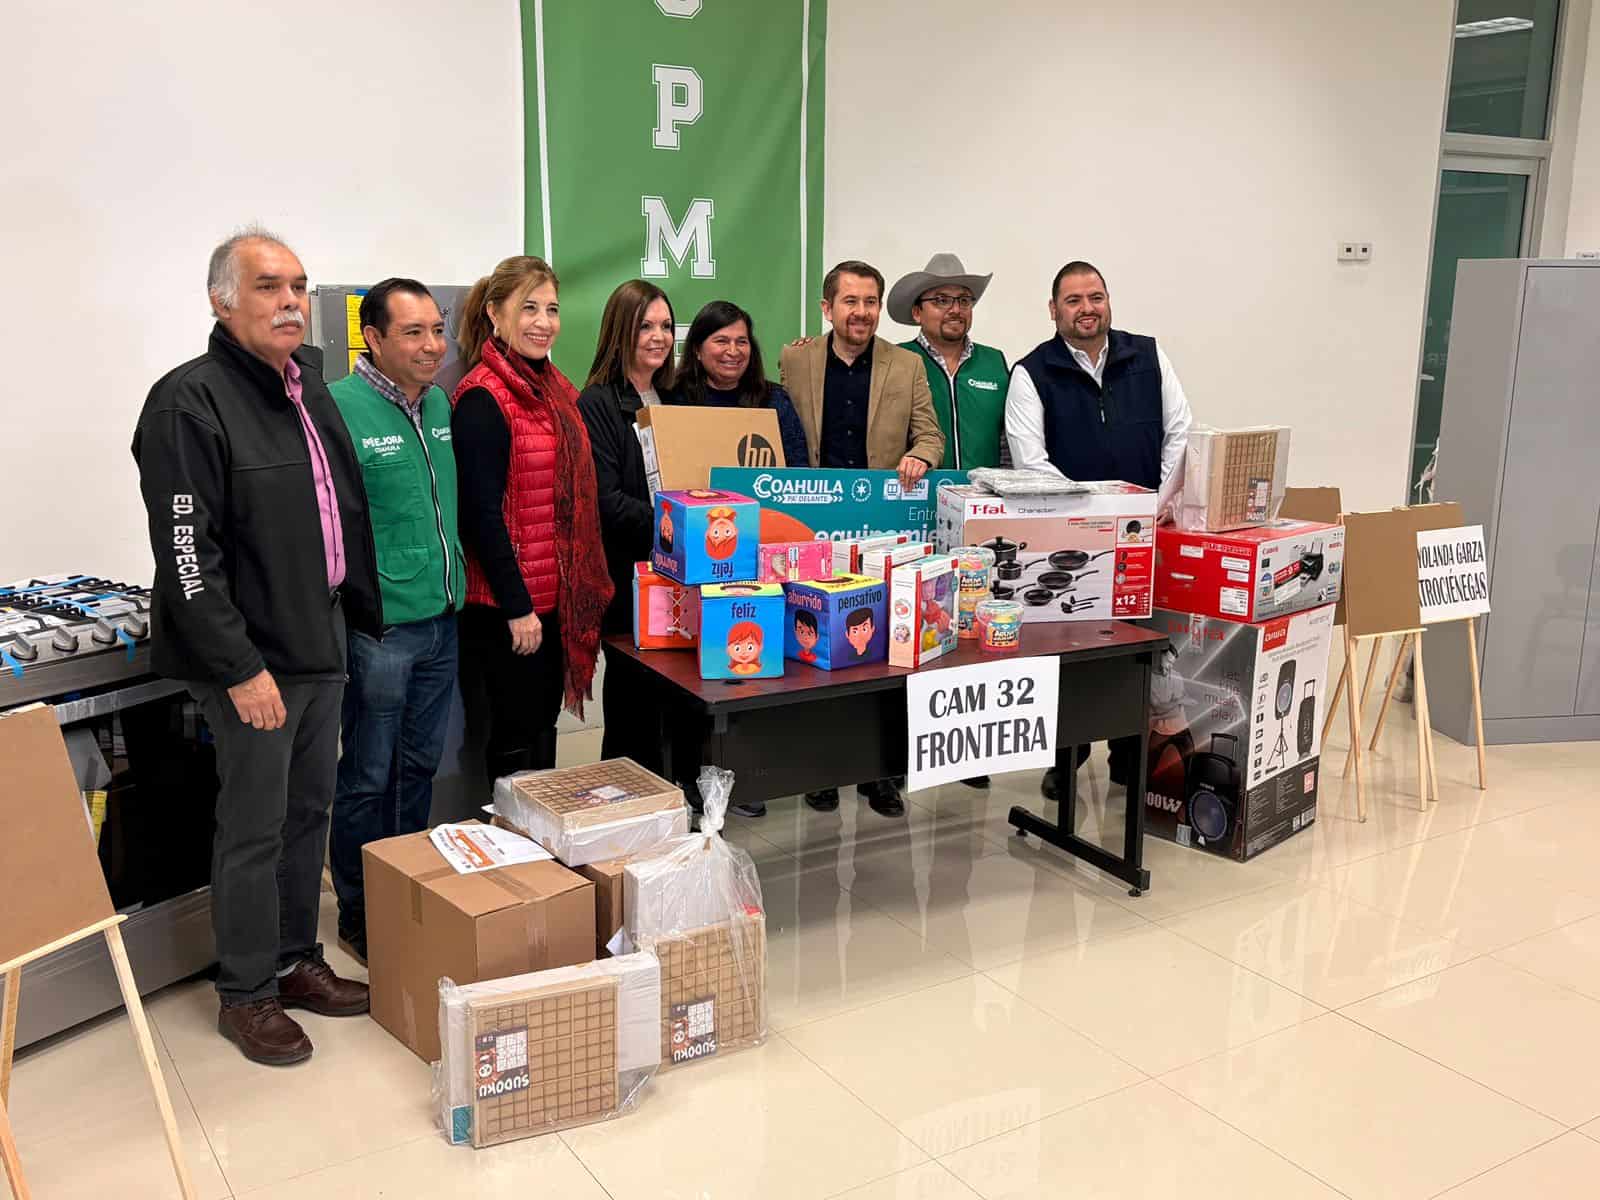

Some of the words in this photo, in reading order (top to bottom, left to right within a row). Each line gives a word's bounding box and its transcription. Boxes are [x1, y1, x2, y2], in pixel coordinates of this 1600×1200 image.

[361, 435, 404, 449] MEJORA
[753, 474, 843, 498] COAHUILA
[172, 494, 194, 519] ED.
[800, 495, 829, 503] DELANTE
[173, 526, 205, 600] ESPECIAL
[1456, 540, 1484, 564] GARZA
[711, 562, 734, 579] feliz
[730, 601, 757, 619] feliz
[787, 587, 823, 611] aburrido
[838, 588, 882, 614] pensativo
[1115, 595, 1137, 606] x12
[1264, 628, 1286, 642] aiwa
[929, 682, 986, 718] CAM
[996, 677, 1035, 708] 32
[916, 716, 1048, 772] FRONTERA
[674, 1039, 717, 1063] SUDOKU
[479, 1073, 530, 1097] SUDOKU
